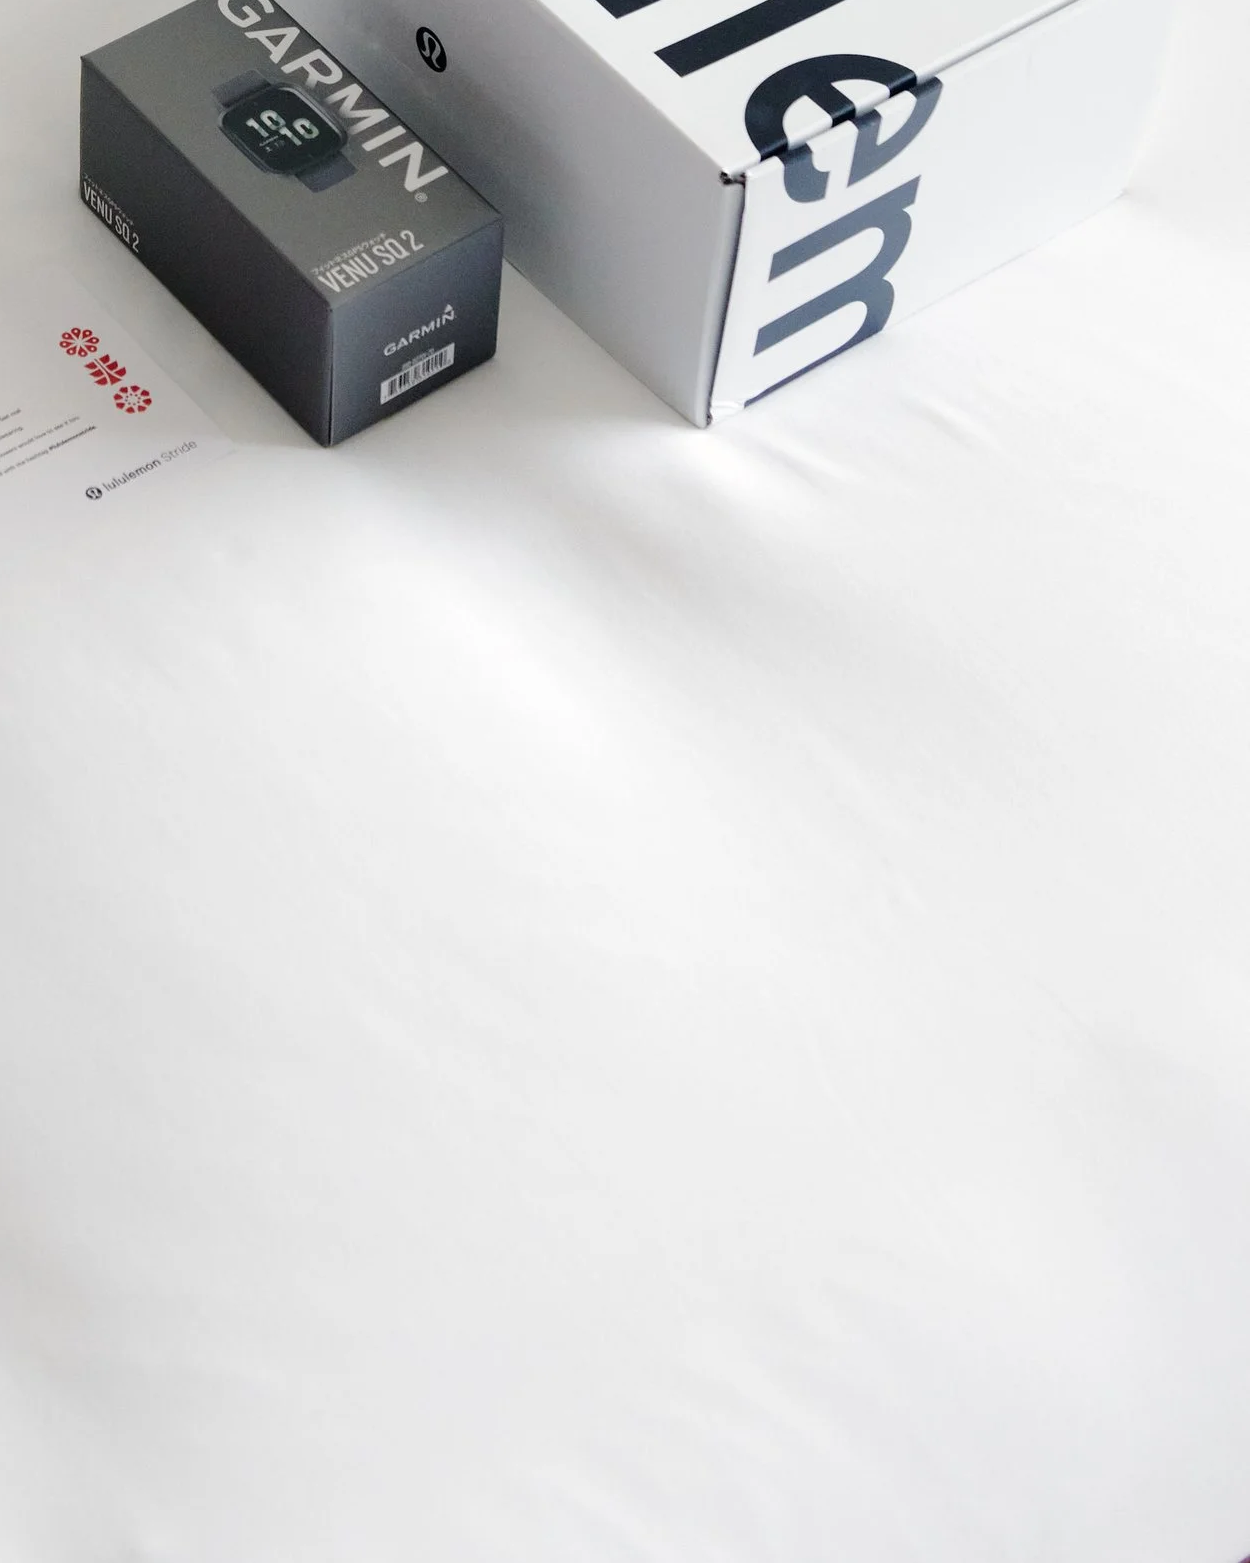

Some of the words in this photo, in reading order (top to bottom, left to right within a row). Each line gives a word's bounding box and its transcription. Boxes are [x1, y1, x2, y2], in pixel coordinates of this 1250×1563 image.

[83, 181, 114, 226] VENU
[114, 215, 131, 245] SQ
[131, 232, 141, 254] 2
[317, 251, 380, 294] VENU
[372, 238, 411, 267] SQ
[399, 230, 425, 252] 2
[101, 456, 162, 493] lululemon
[160, 439, 198, 465] Stride
